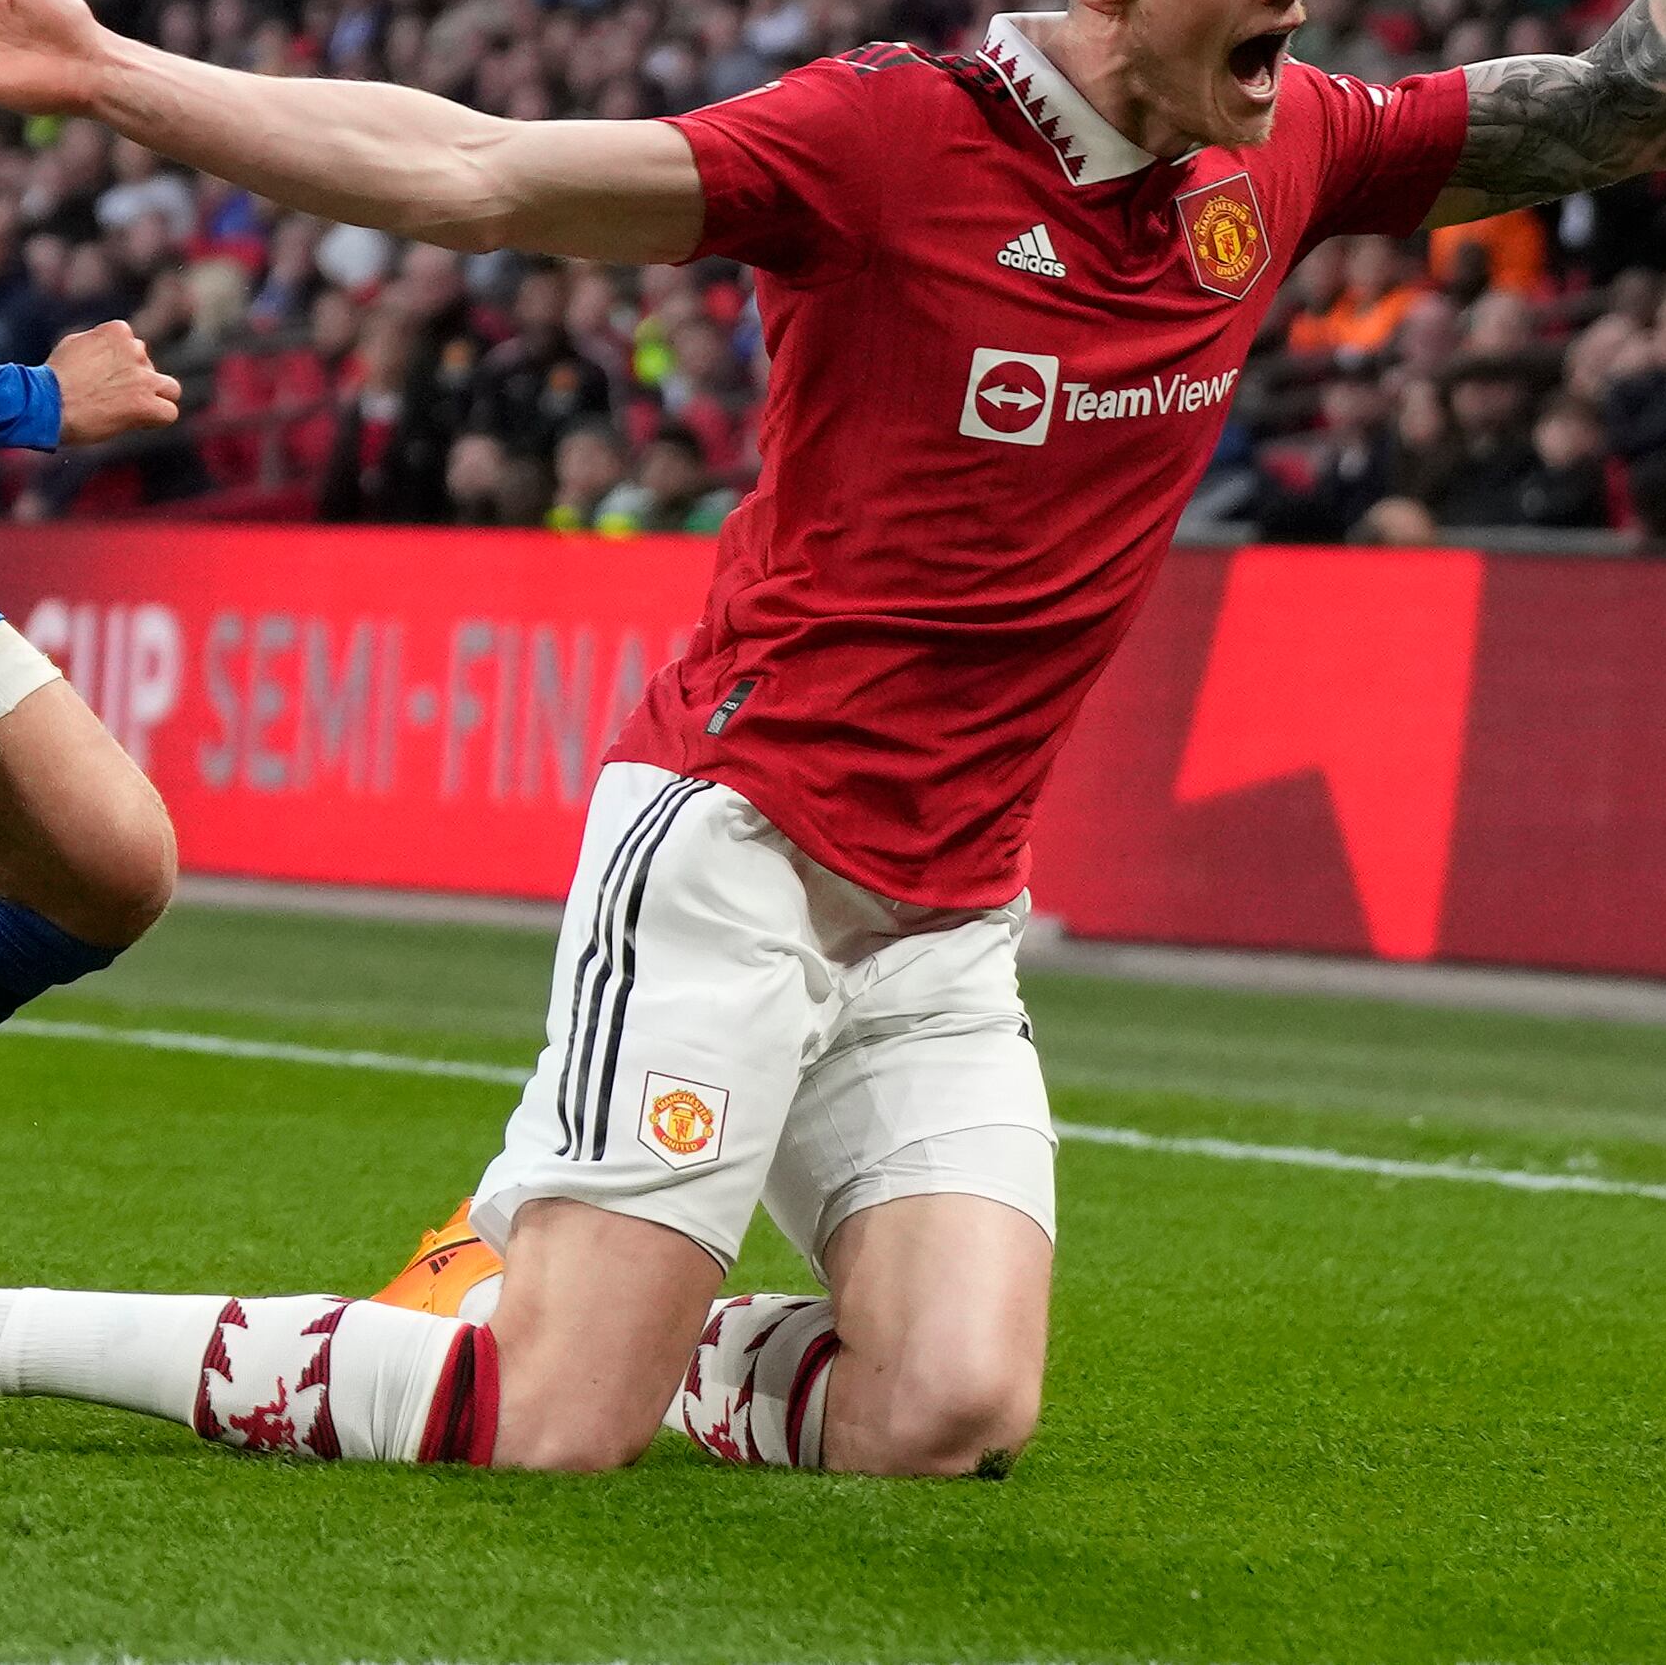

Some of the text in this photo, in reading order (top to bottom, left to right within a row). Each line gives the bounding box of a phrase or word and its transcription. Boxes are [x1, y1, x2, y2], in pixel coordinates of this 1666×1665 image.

[1199, 200, 1248, 237] MANCHESTER
[997, 249, 1067, 278] adidas
[1216, 255, 1251, 276] UNITED
[200, 612, 691, 804] SEMI-FINA
[657, 1093, 711, 1124] MANCHESTER
[661, 1135, 698, 1151] UNITED
